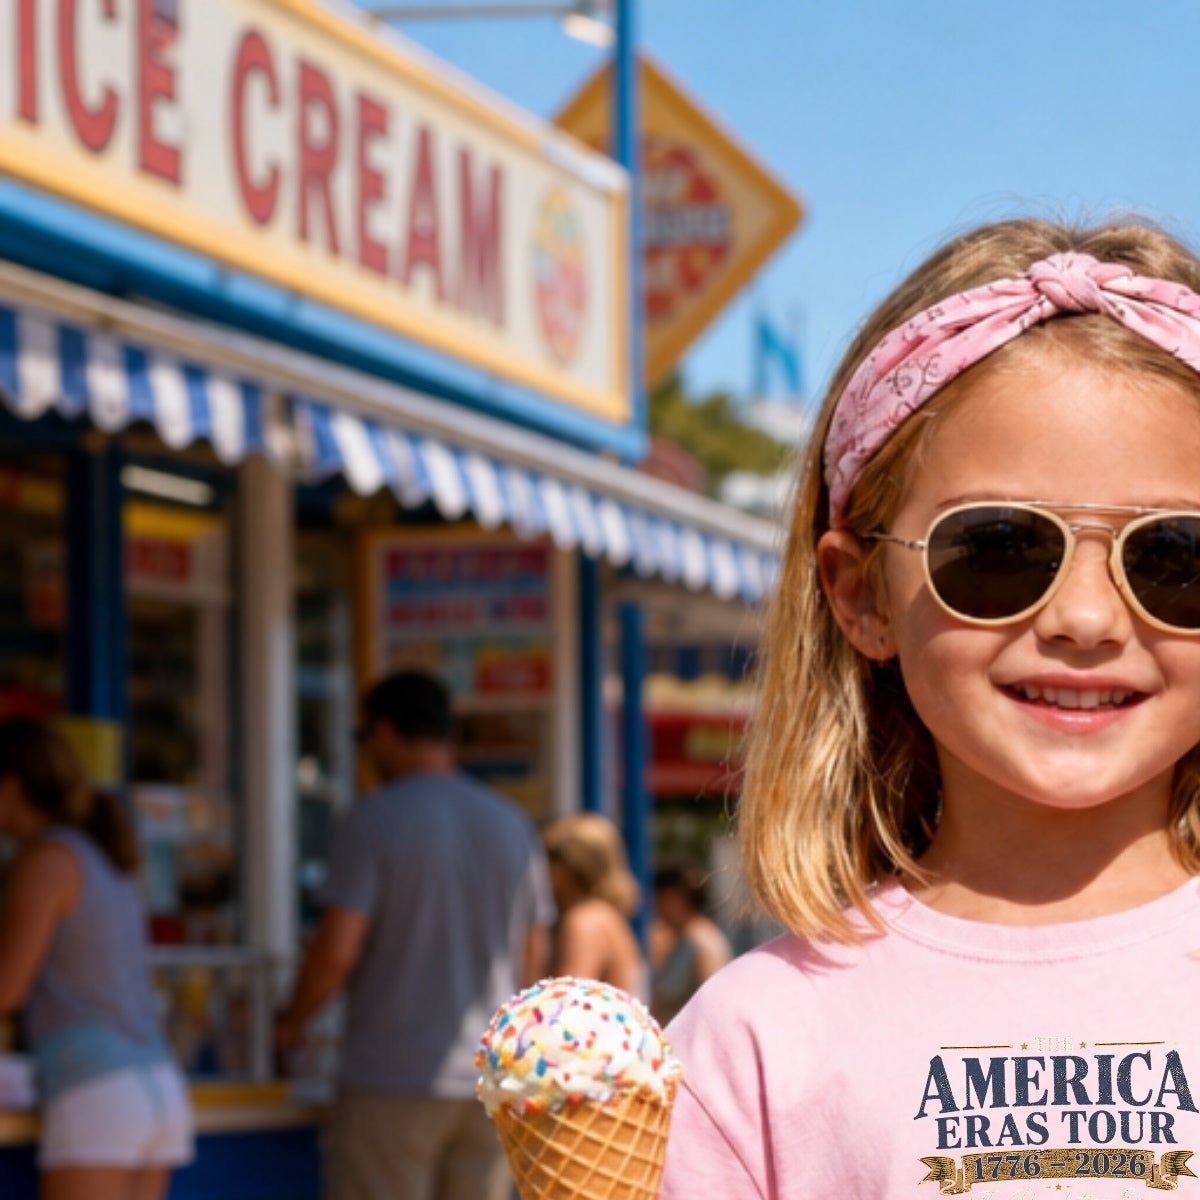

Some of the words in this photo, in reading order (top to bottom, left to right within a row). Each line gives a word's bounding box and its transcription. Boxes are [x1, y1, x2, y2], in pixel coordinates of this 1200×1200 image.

[17, 0, 181, 187] ICE
[231, 28, 504, 328] CREAM
[913, 1049, 1200, 1120] AMERICA
[934, 1110, 1050, 1150] ERAS
[1061, 1109, 1178, 1144] TOUR
[974, 1153, 1042, 1180] 1776
[1074, 1152, 1147, 1177] 2026
